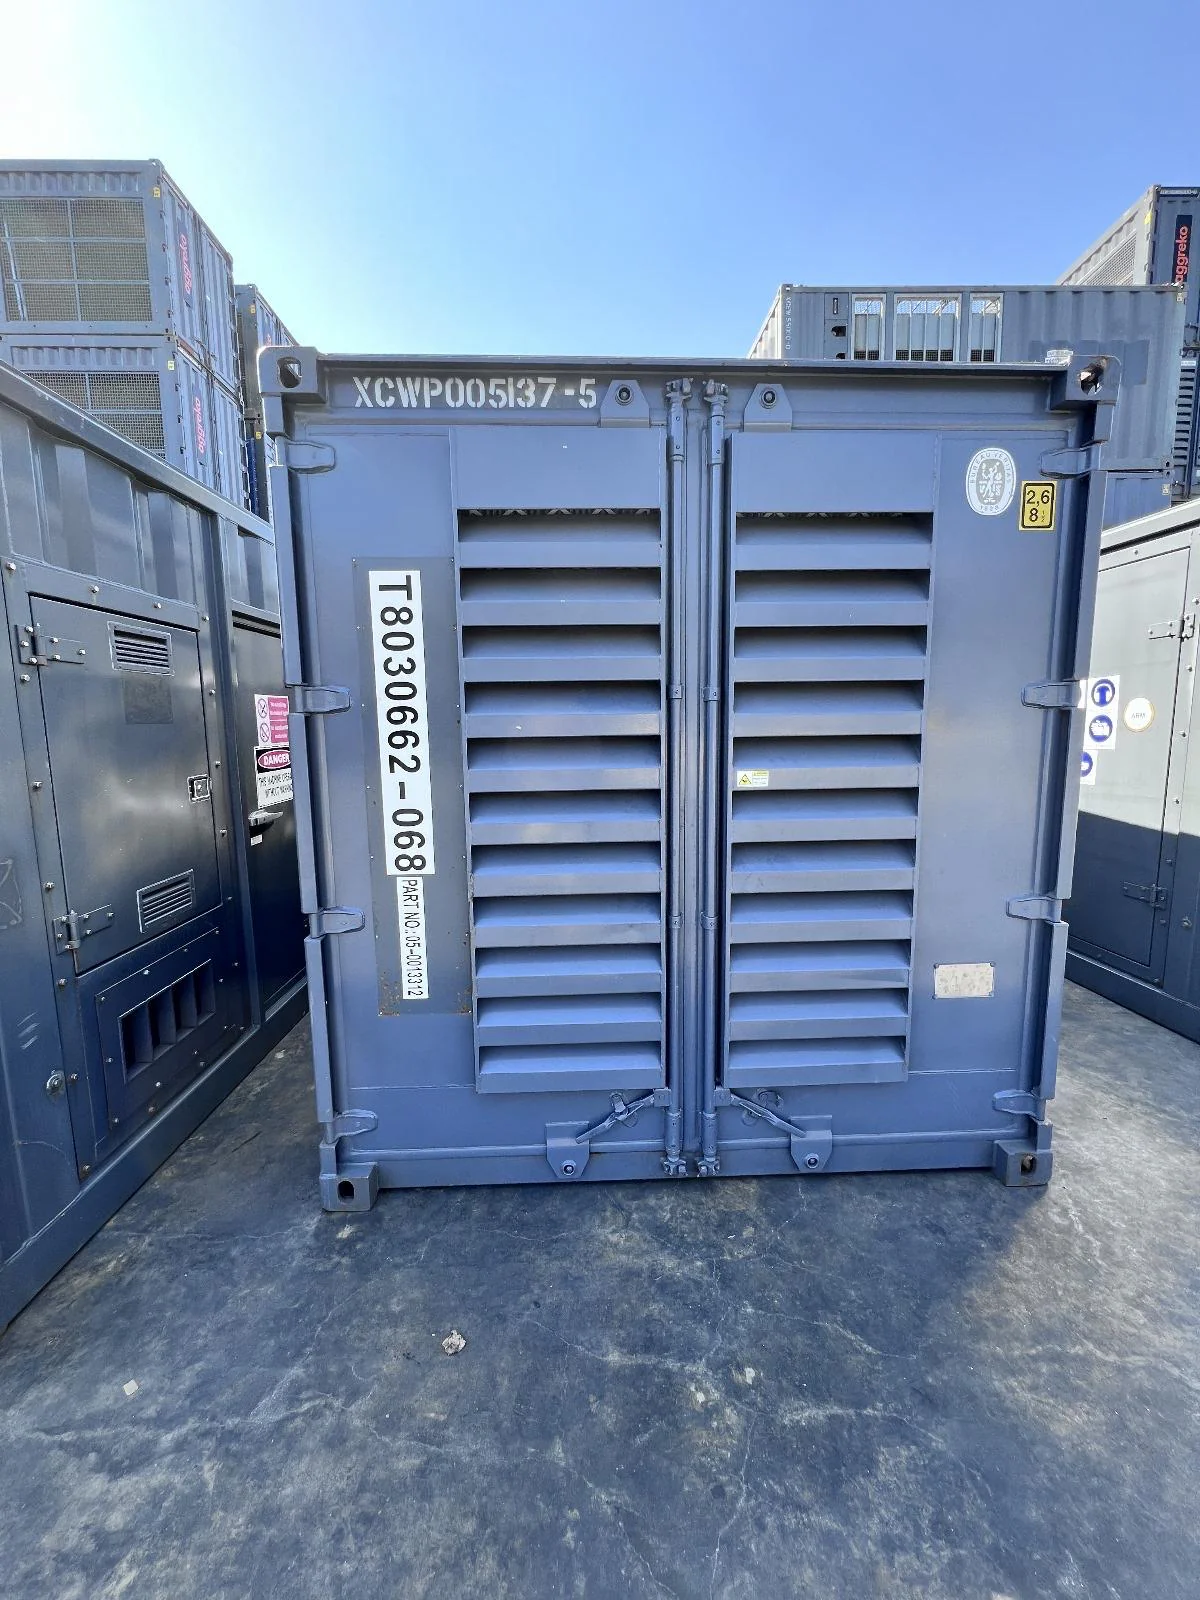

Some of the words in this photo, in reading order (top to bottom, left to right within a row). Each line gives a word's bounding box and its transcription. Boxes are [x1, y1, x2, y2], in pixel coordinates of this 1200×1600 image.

[1175, 225, 1189, 285] aggreko
[1026, 490, 1050, 507] 2,6
[379, 574, 427, 872] T8030662-068
[263, 753, 290, 766] DANGER
[402, 879, 419, 909] PART
